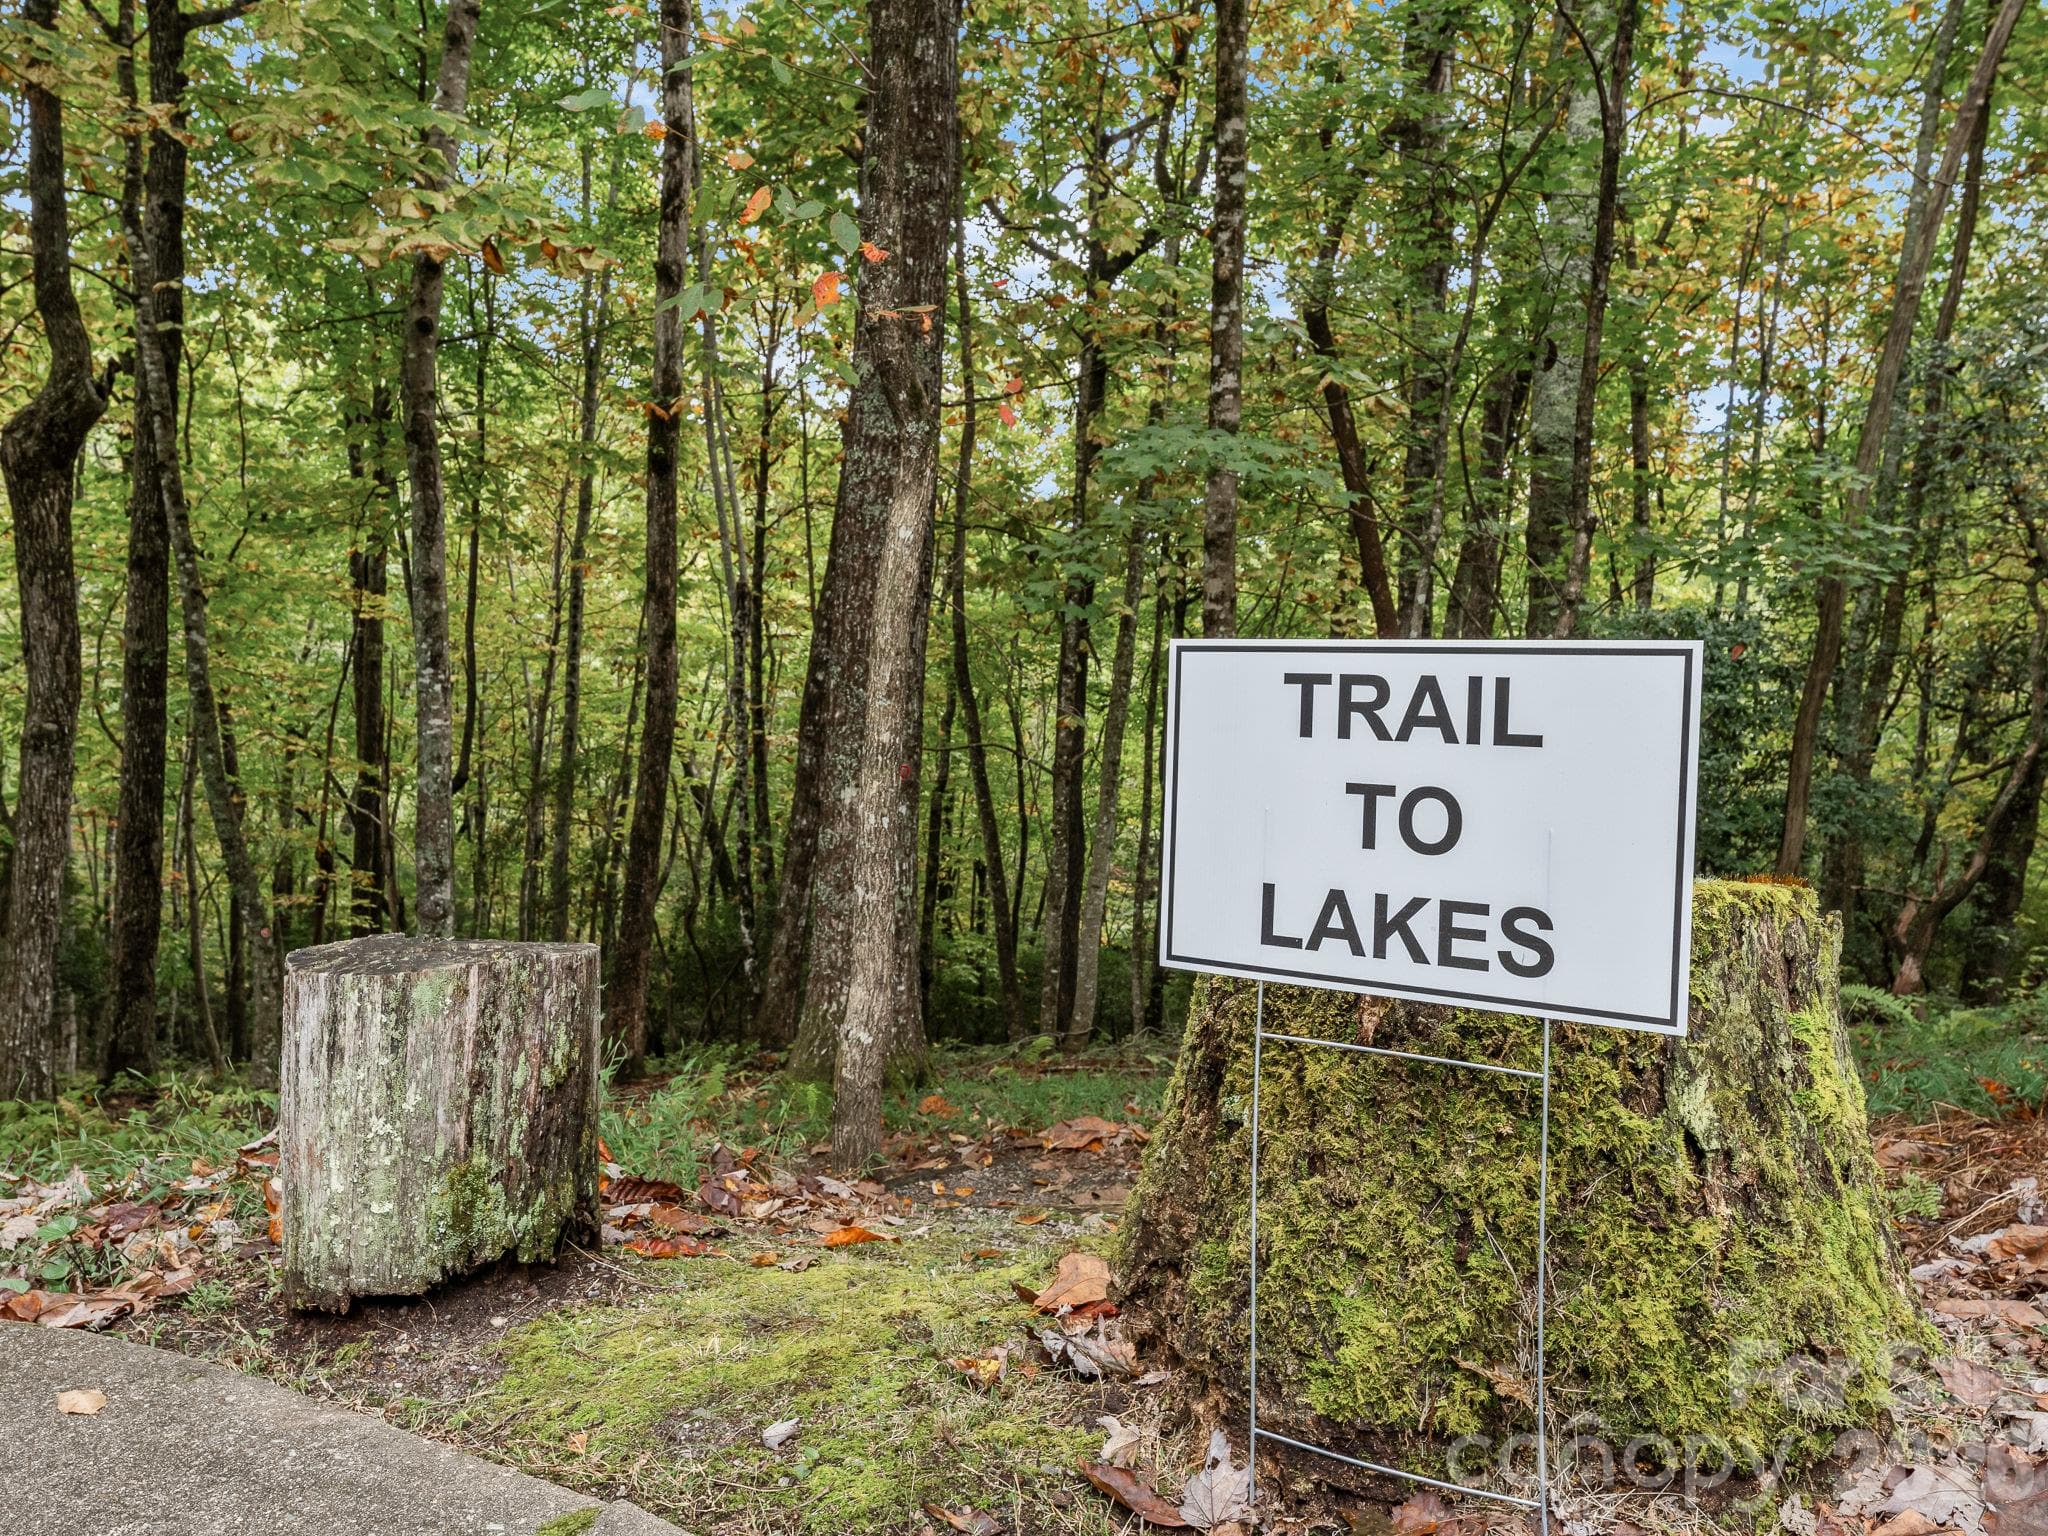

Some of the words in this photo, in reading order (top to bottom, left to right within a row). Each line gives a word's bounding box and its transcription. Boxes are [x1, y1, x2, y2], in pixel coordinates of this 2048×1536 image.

[1283, 672, 1544, 748] TRAIL
[1345, 782, 1463, 856] TO
[1260, 882, 1555, 979] LAKES
